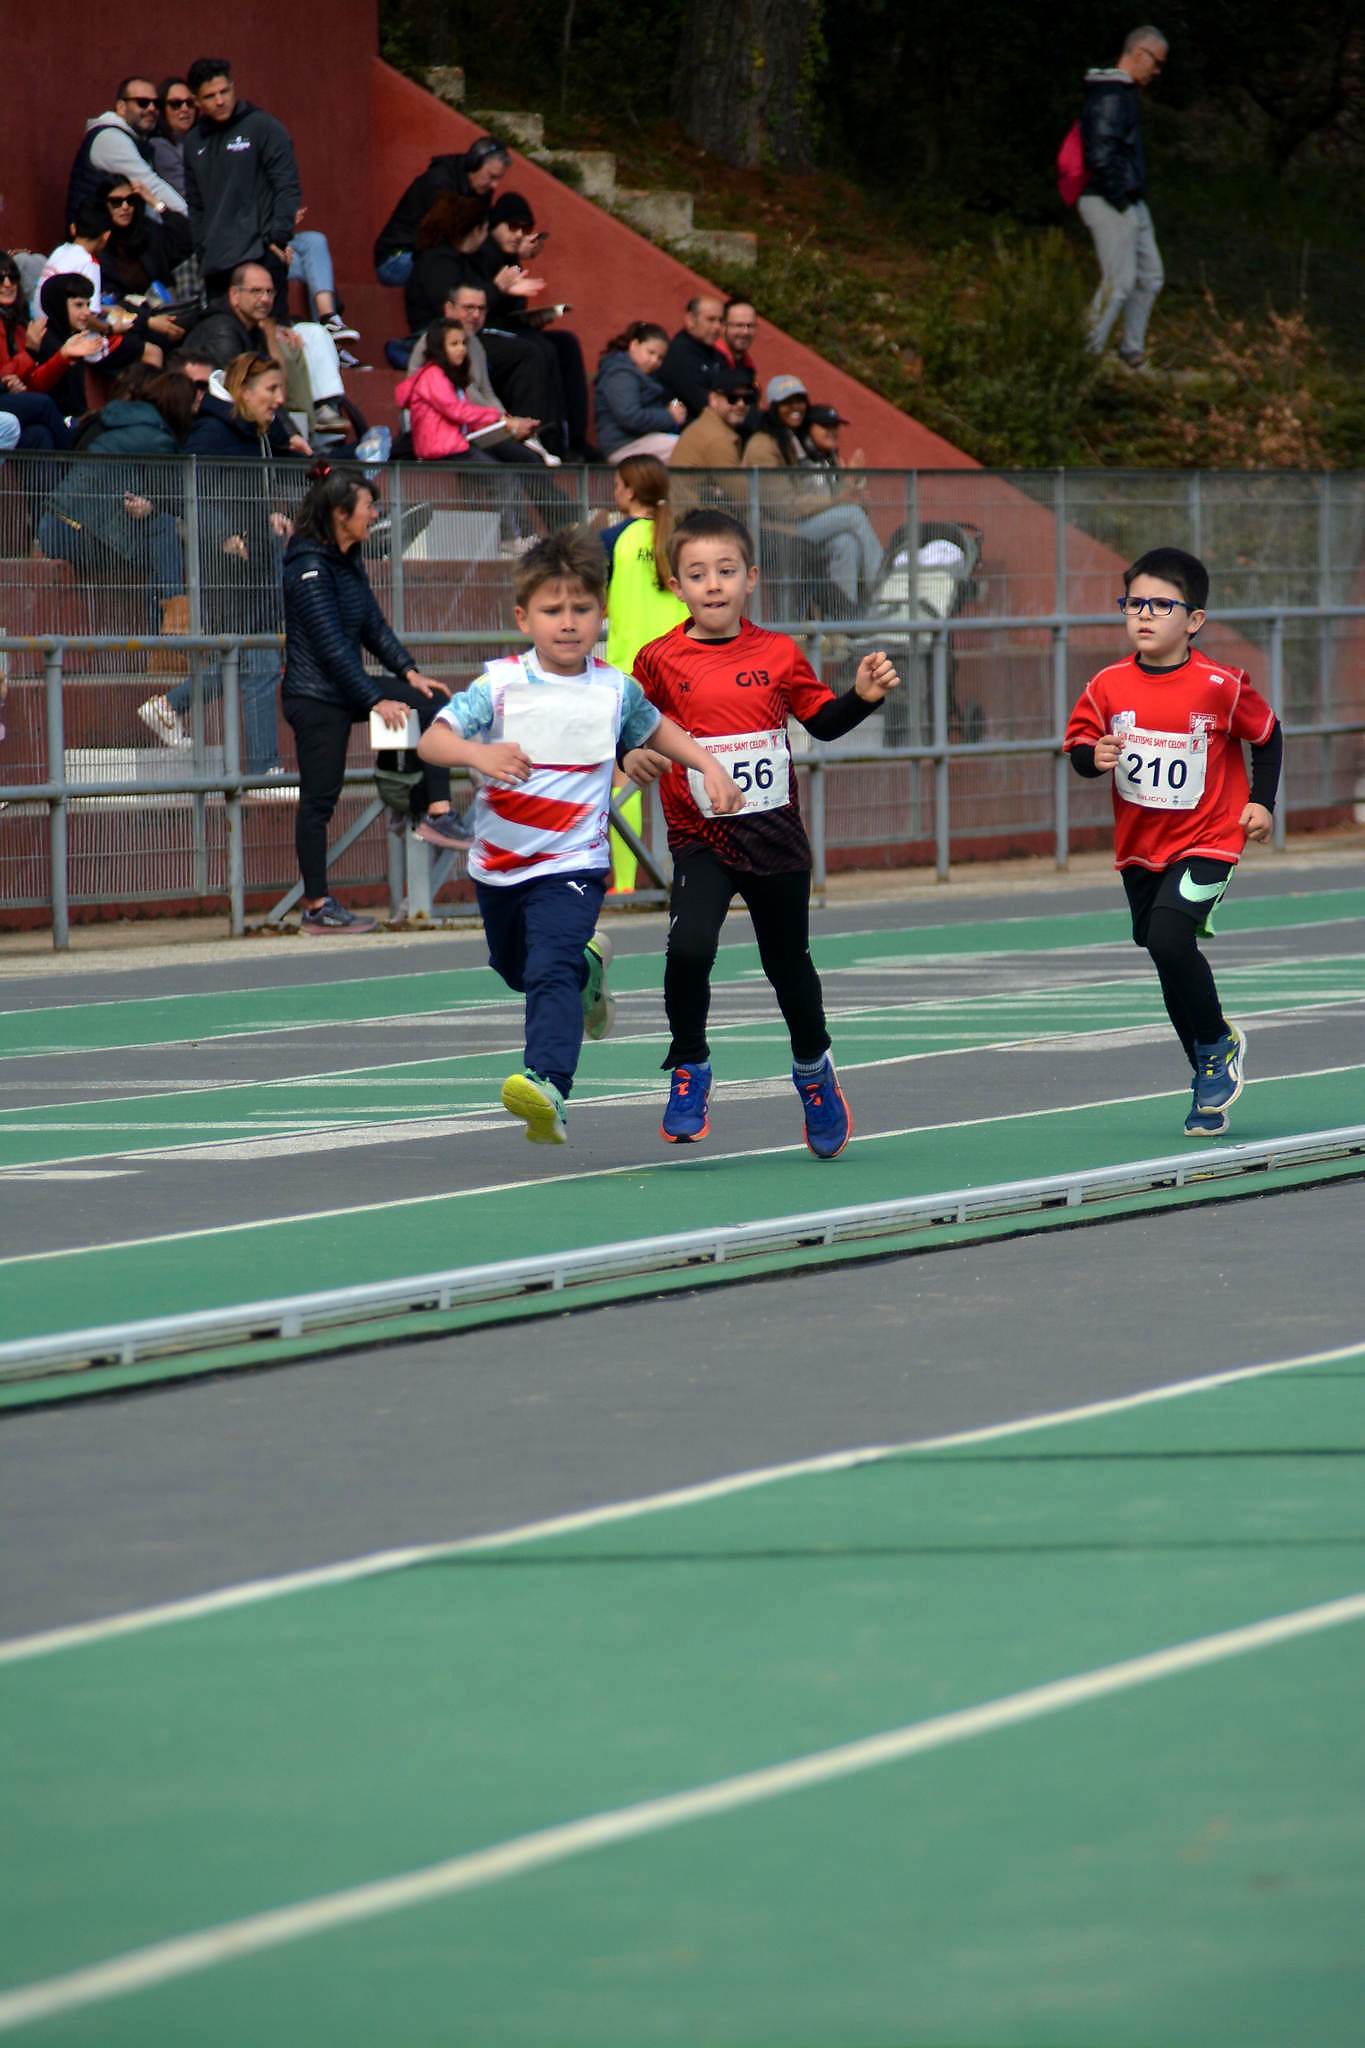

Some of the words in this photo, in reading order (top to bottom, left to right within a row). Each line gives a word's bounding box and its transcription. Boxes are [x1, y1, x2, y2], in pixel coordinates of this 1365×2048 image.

[734, 741, 748, 751] SANT
[750, 739, 768, 749] CELONI
[1128, 734, 1153, 746] ATLETISME
[1153, 738, 1167, 748] SANT
[1168, 740, 1187, 749] CELONI
[733, 758, 773, 792] 56
[1127, 753, 1187, 789] 210
